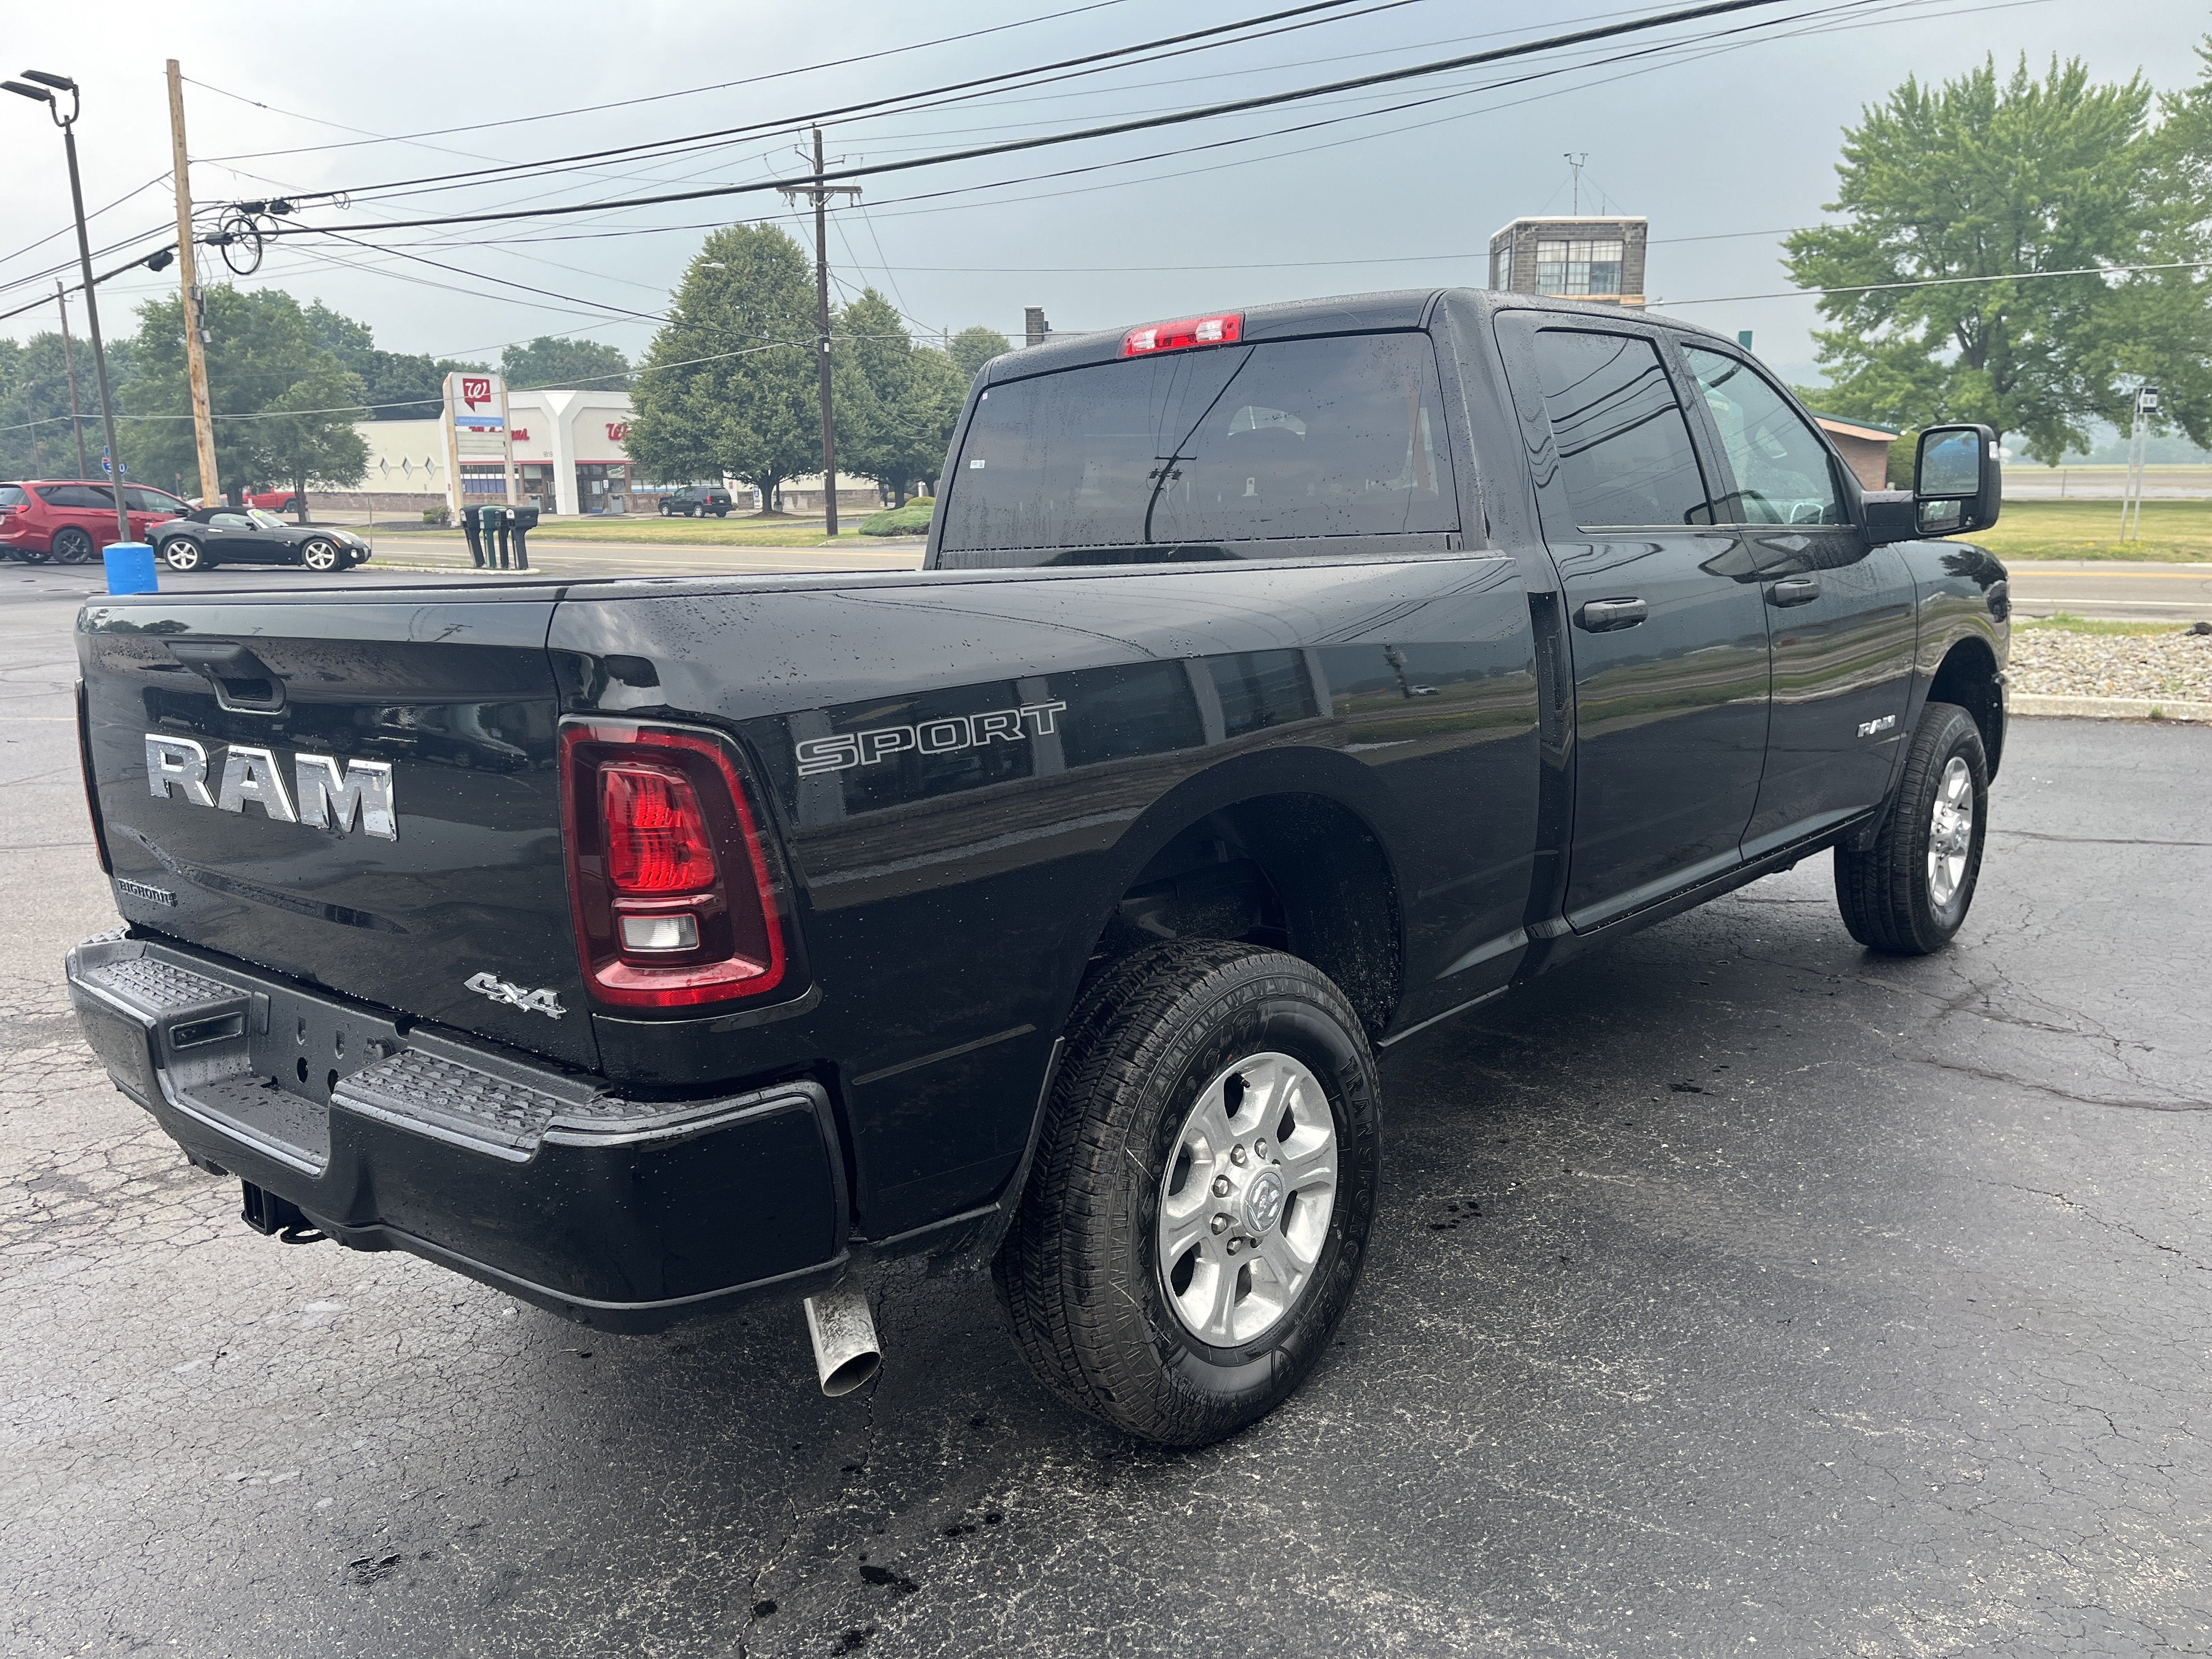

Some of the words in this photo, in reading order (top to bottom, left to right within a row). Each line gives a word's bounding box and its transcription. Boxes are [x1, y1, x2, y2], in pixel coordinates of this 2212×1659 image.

[465, 381, 487, 399] W
[107, 462, 125, 472] 30
[795, 700, 1067, 776] SPORT
[1858, 714, 1895, 738] RAM
[145, 733, 399, 842] RAM
